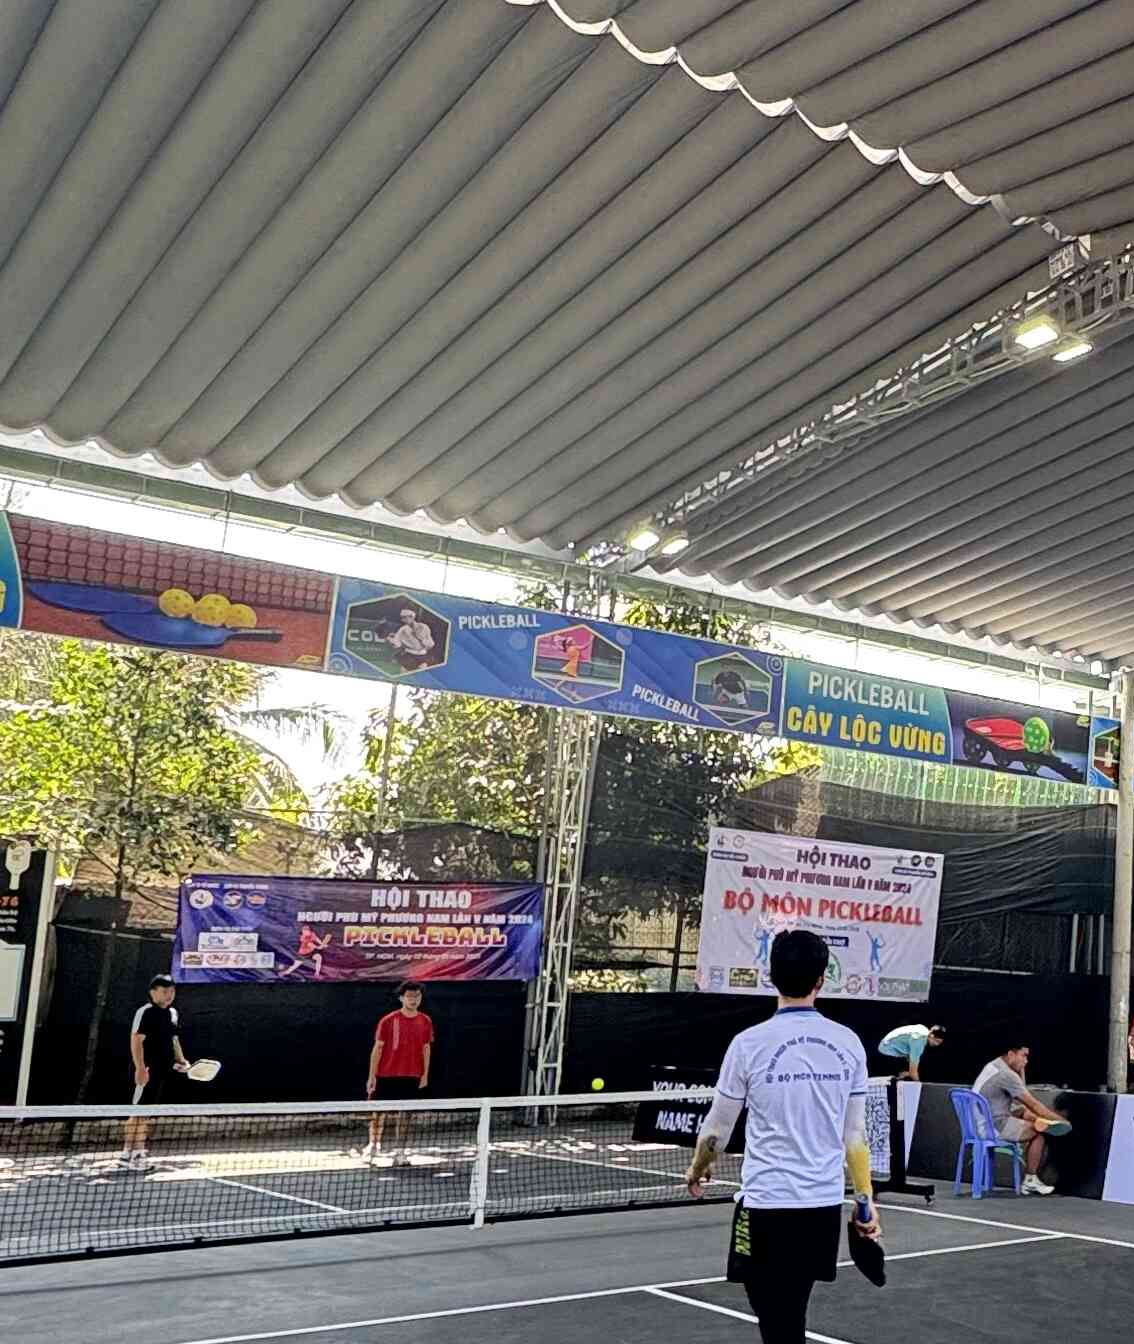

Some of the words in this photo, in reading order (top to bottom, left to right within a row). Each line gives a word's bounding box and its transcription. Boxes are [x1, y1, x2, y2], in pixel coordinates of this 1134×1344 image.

[458, 613, 541, 630] PICKLEBALL
[632, 683, 700, 722] PICKLEBALL
[808, 670, 930, 716] PICKLEBALL
[787, 705, 833, 737] CÂY
[839, 713, 881, 747] LỘC
[796, 845, 826, 871] HỘI
[830, 852, 871, 870] THAO
[370, 886, 410, 911] HỘI
[416, 889, 473, 909] THAO
[722, 887, 754, 915] BỘ
[760, 891, 812, 916] MÔN
[818, 898, 923, 926] PICKLEBALL
[343, 925, 508, 948] PICKLEBALL
[655, 1110, 696, 1133] NAME
